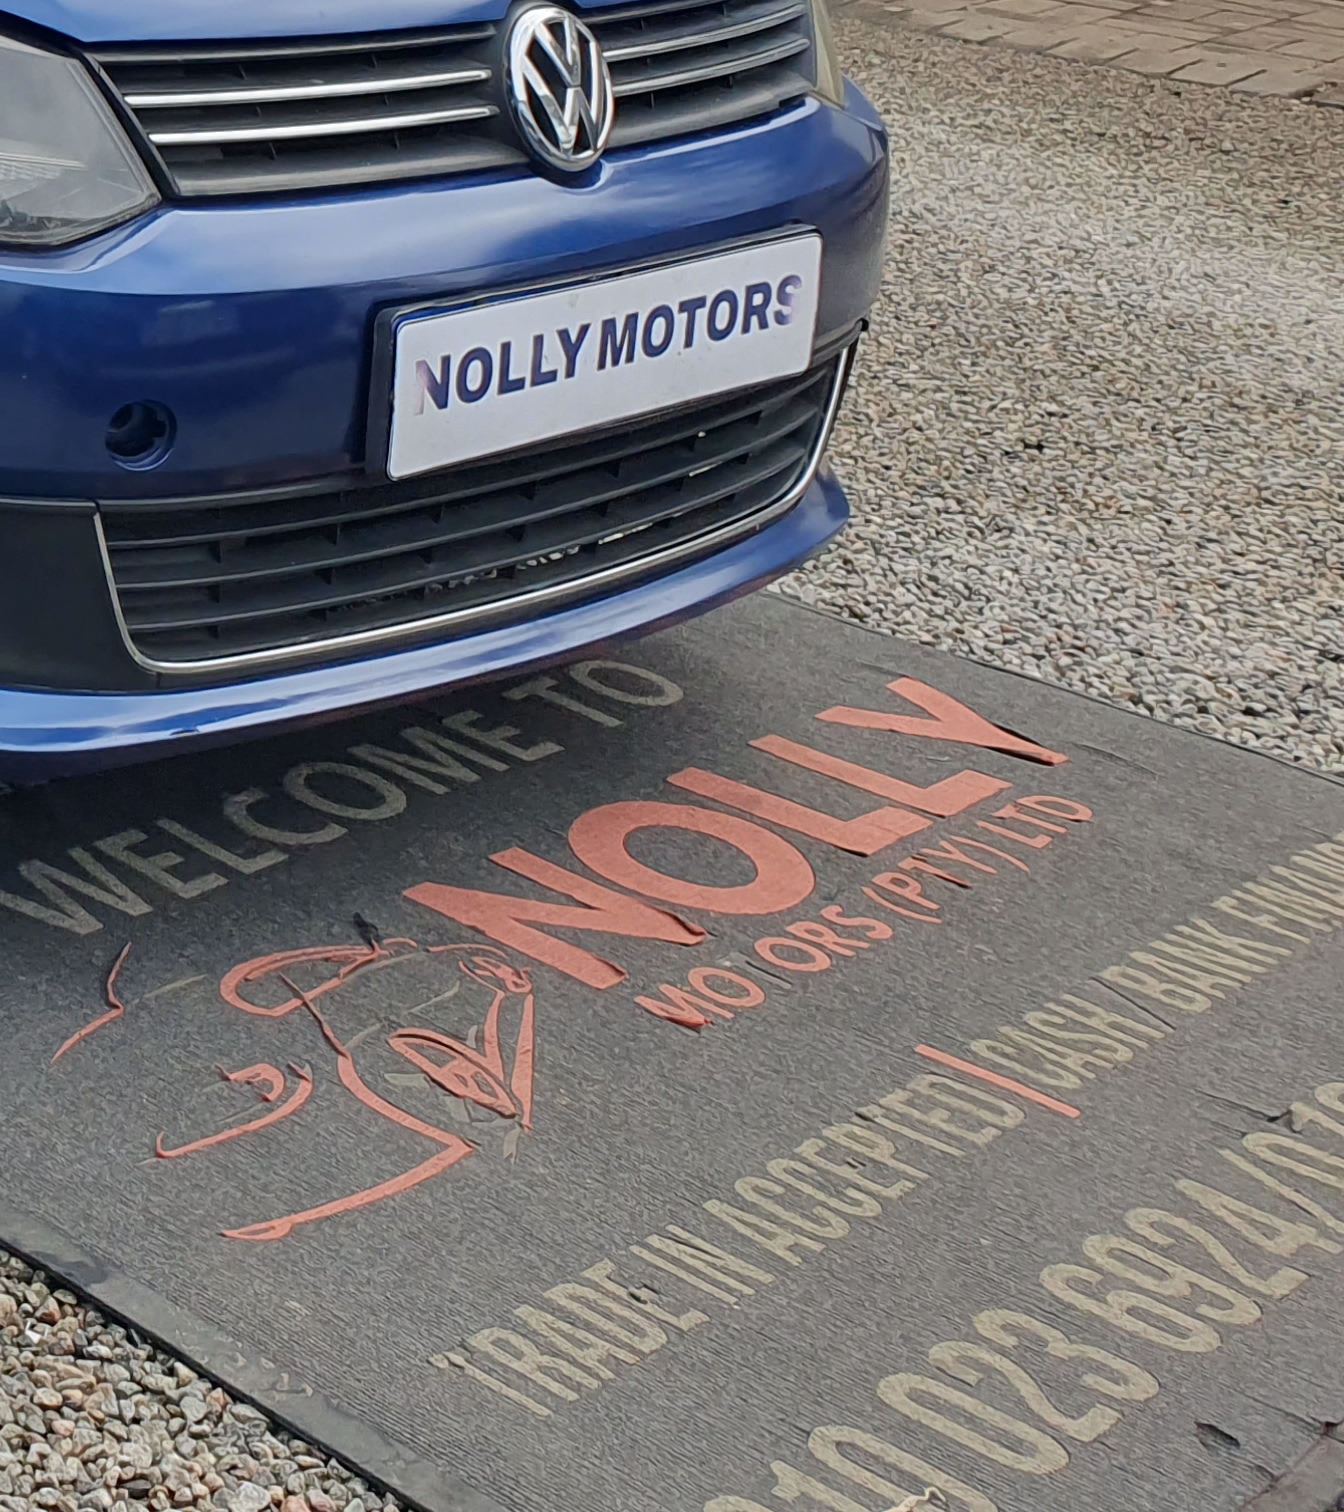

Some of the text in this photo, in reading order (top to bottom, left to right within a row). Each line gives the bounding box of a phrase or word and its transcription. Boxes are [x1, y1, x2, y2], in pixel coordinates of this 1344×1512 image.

[414, 275, 803, 416] NOLLY MOTORS
[503, 659, 684, 728] TO
[402, 675, 1070, 991] NOLLY
[634, 795, 1094, 1032] MOORS (PTY) LTD
[428, 1257, 710, 1418] TRADE
[629, 1224, 776, 1305] IN
[703, 1073, 1026, 1266] ACCEPTED
[876, 1307, 1161, 1476] 023
